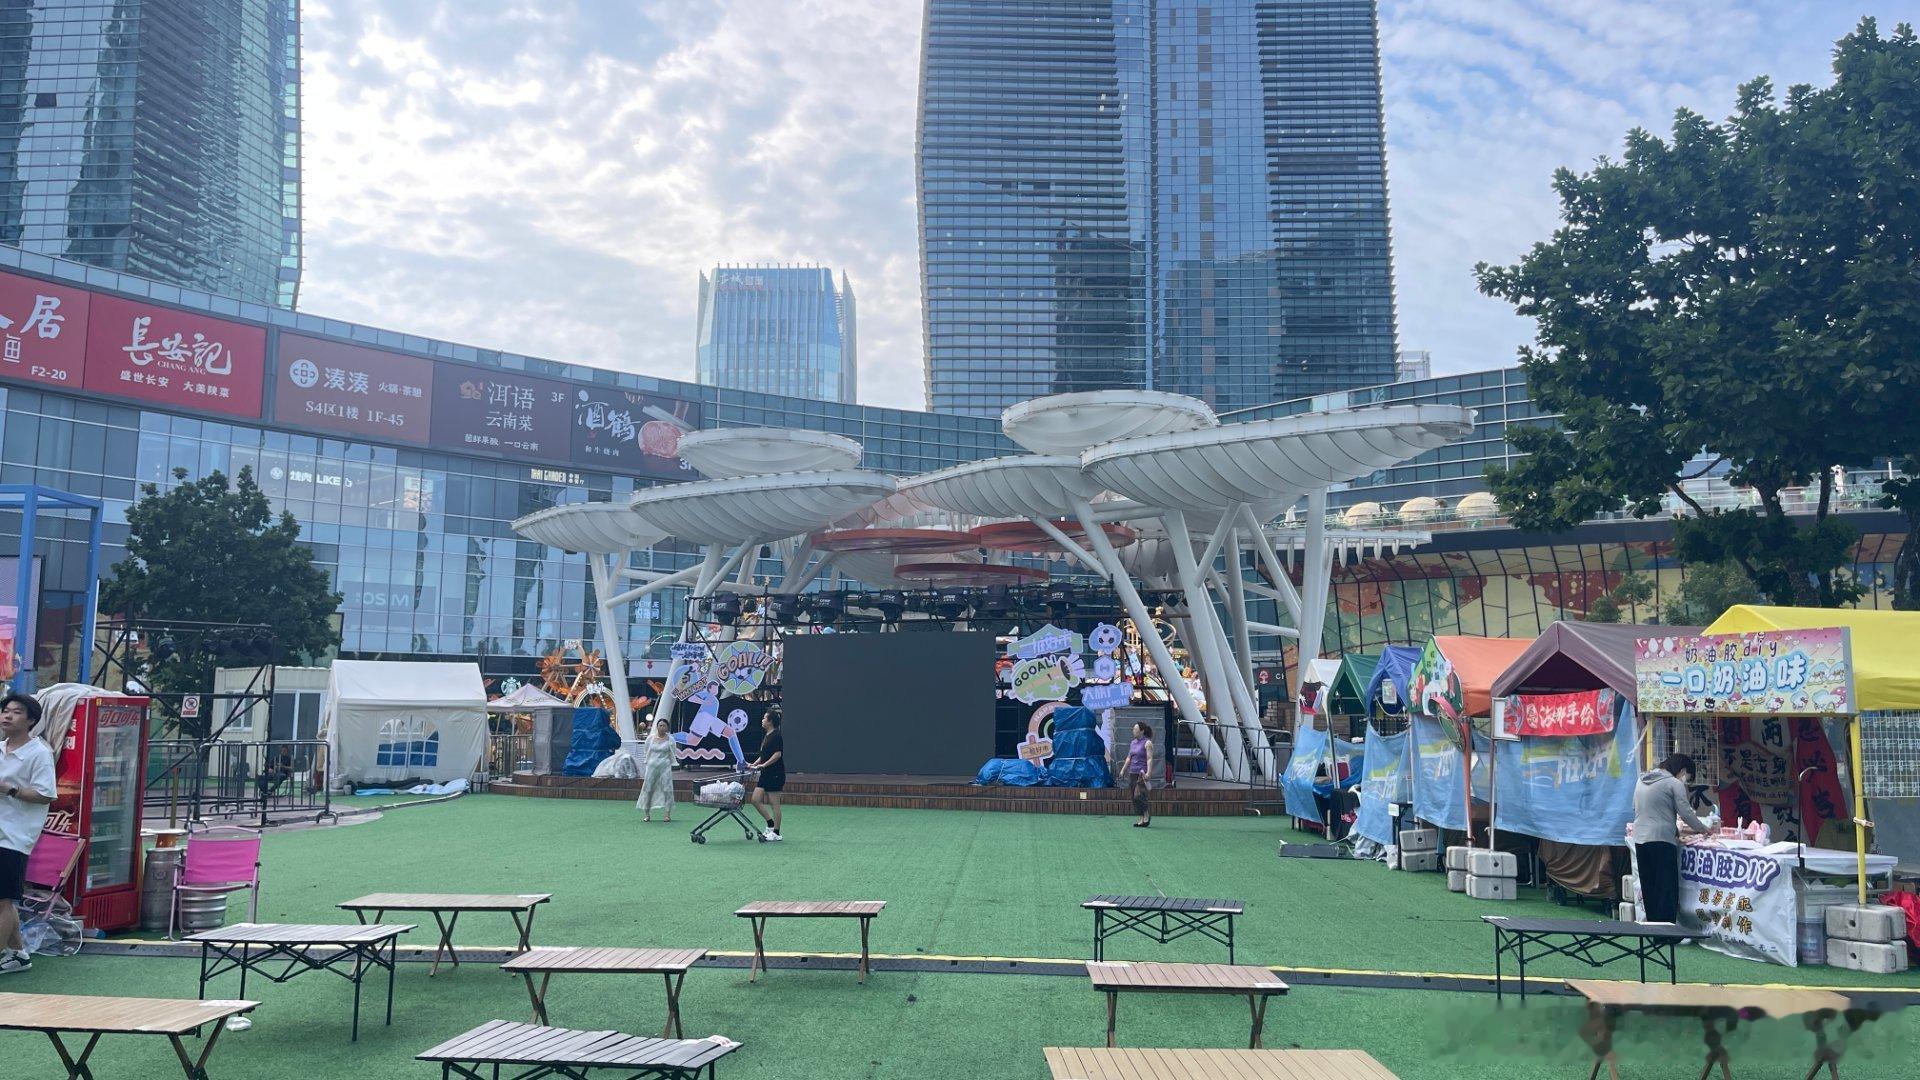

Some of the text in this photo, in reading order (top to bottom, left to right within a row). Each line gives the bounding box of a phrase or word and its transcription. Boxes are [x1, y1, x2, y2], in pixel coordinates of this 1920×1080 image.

[0, 294, 66, 339] 居
[31, 365, 67, 380] F2-20
[157, 360, 187, 372] CHANG
[119, 370, 170, 388] 盛世长安
[487, 381, 565, 410] 洱语 3F
[367, 410, 404, 426] 1F-45
[485, 411, 534, 431] 云南菜
[316, 474, 342, 486] LIKE
[1014, 654, 1057, 687] GOOAL!
[1662, 654, 1807, 695] 一口奶油味
[100, 709, 140, 726] 可口可乐
[1680, 848, 1777, 886] 奶油胶DIY
